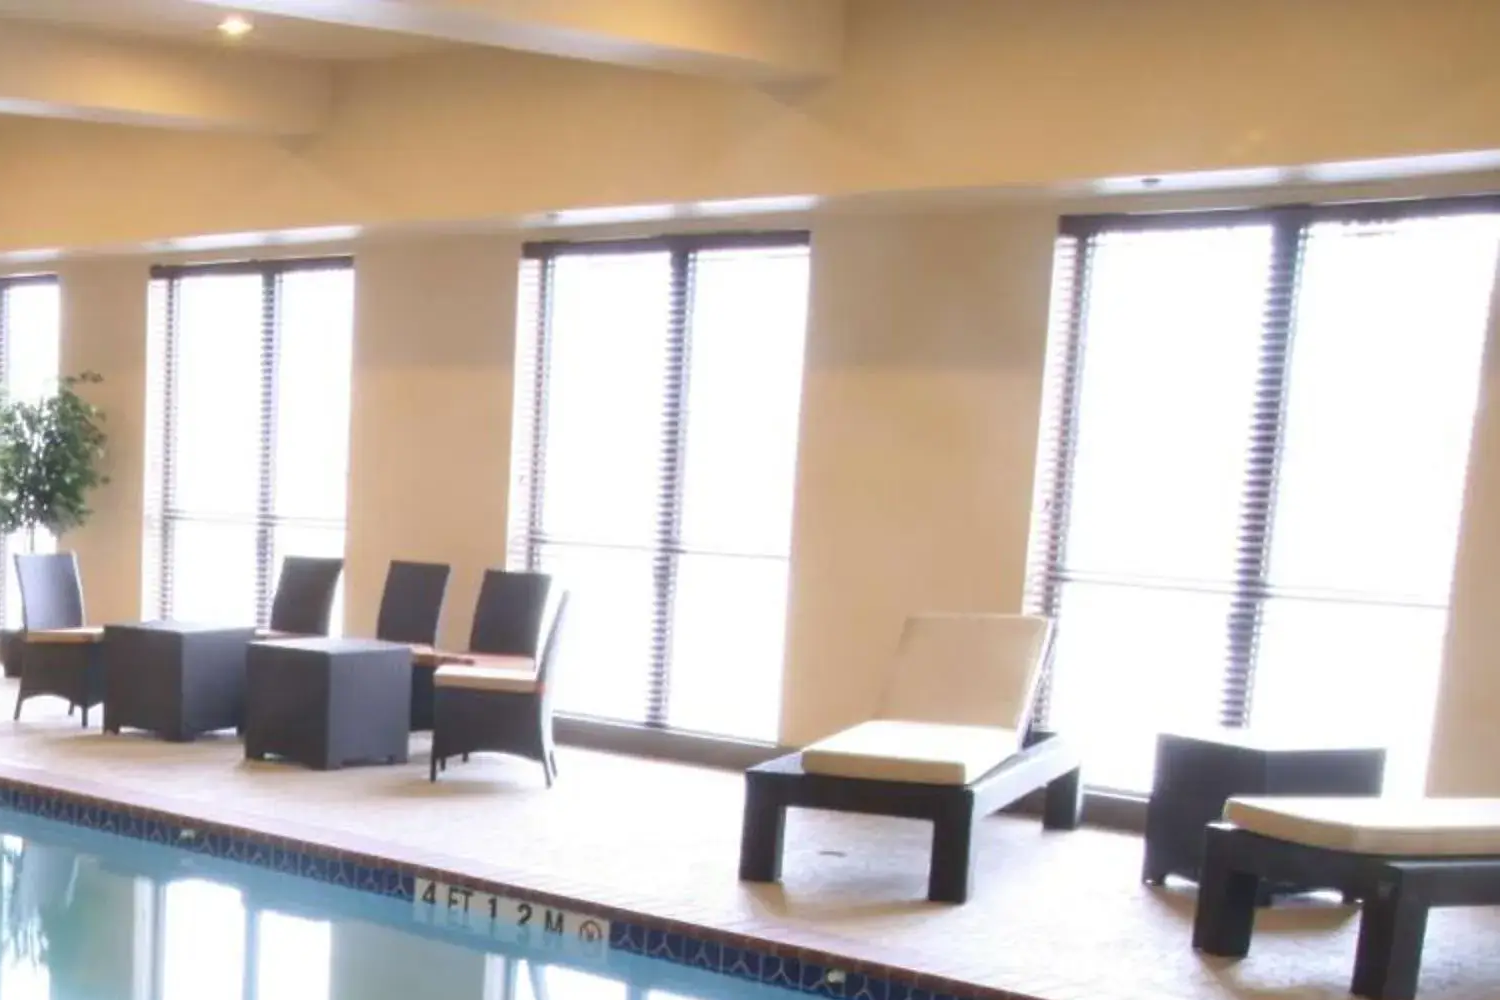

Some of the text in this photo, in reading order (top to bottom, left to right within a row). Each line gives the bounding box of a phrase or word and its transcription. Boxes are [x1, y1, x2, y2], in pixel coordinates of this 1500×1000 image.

[422, 881, 436, 906] 4
[448, 885, 474, 913] FT
[545, 909, 564, 936] M
